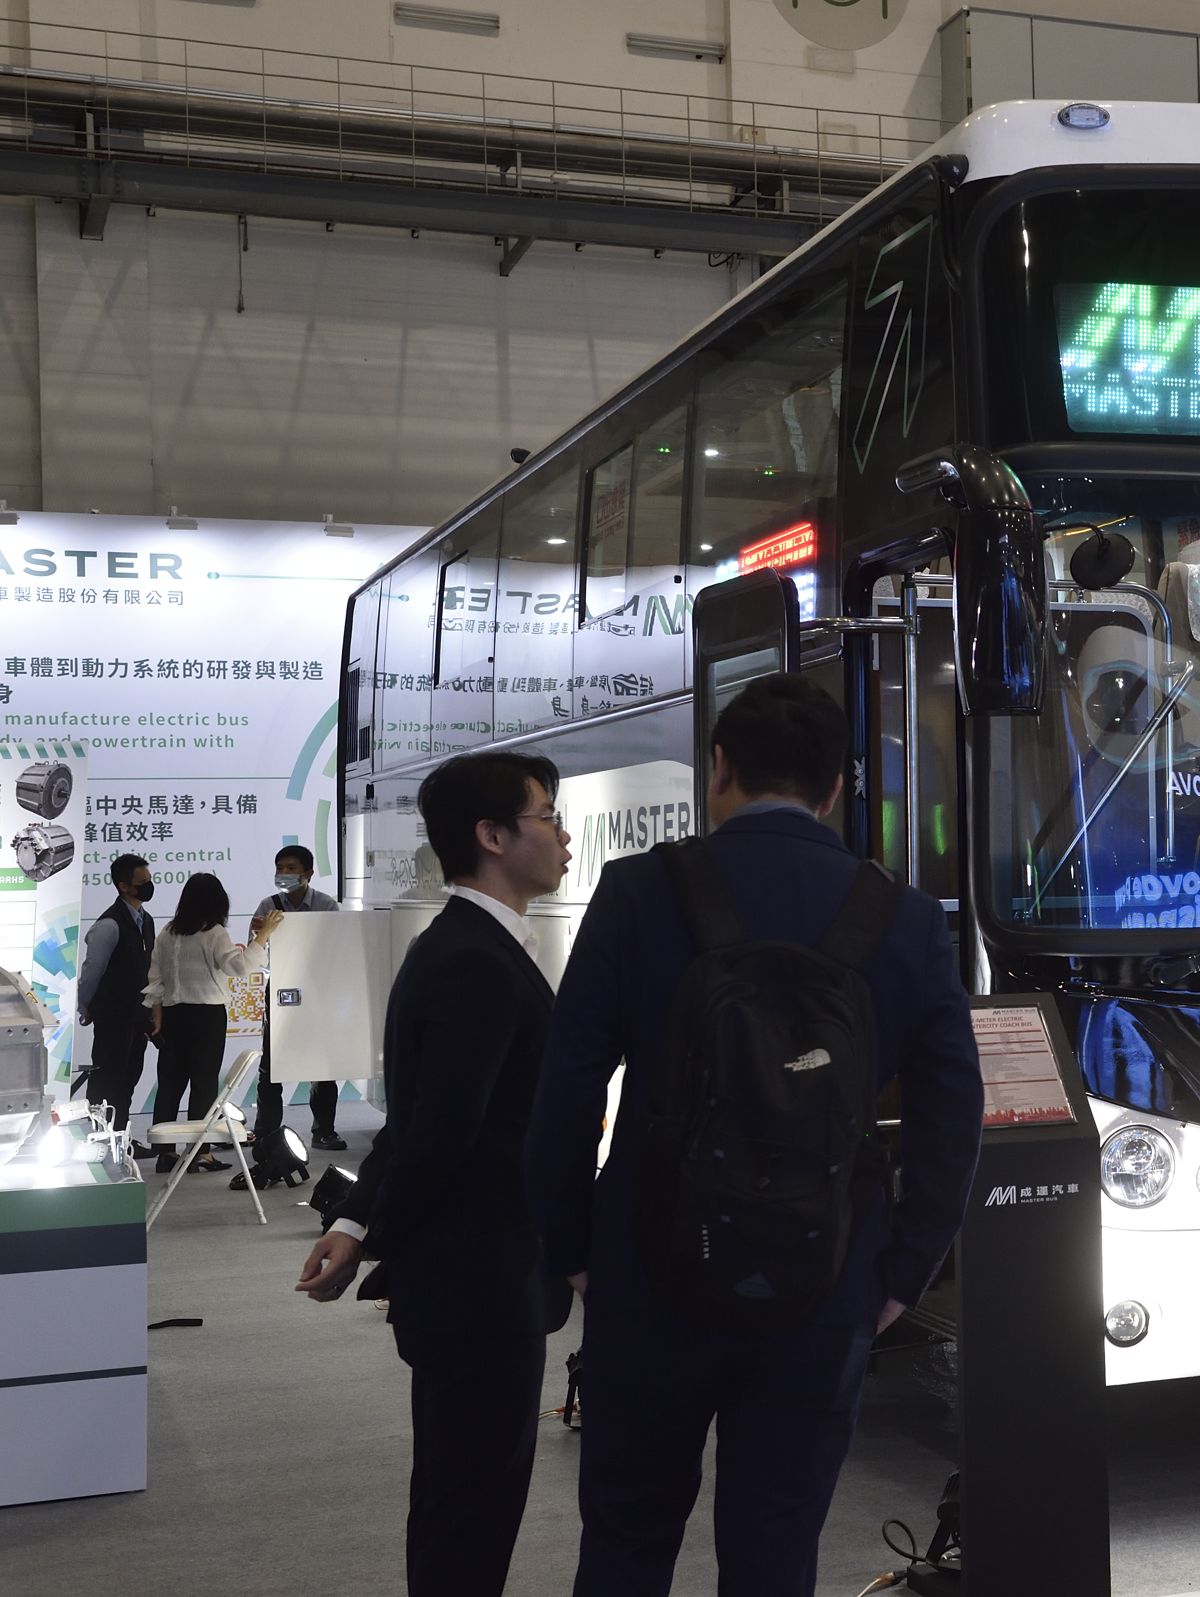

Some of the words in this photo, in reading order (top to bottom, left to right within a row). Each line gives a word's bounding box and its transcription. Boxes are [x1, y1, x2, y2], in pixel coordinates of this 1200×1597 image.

[4, 656, 324, 681] 車體到動力系統的研發與製造
[5, 713, 131, 726] manufacture
[138, 712, 211, 727] electric
[217, 712, 250, 727] bus
[80, 734, 188, 749] owertrain
[194, 734, 235, 749] with
[608, 801, 691, 850] MASTER
[165, 847, 232, 862] central
[1020, 1183, 1080, 1198] 成運汽車
